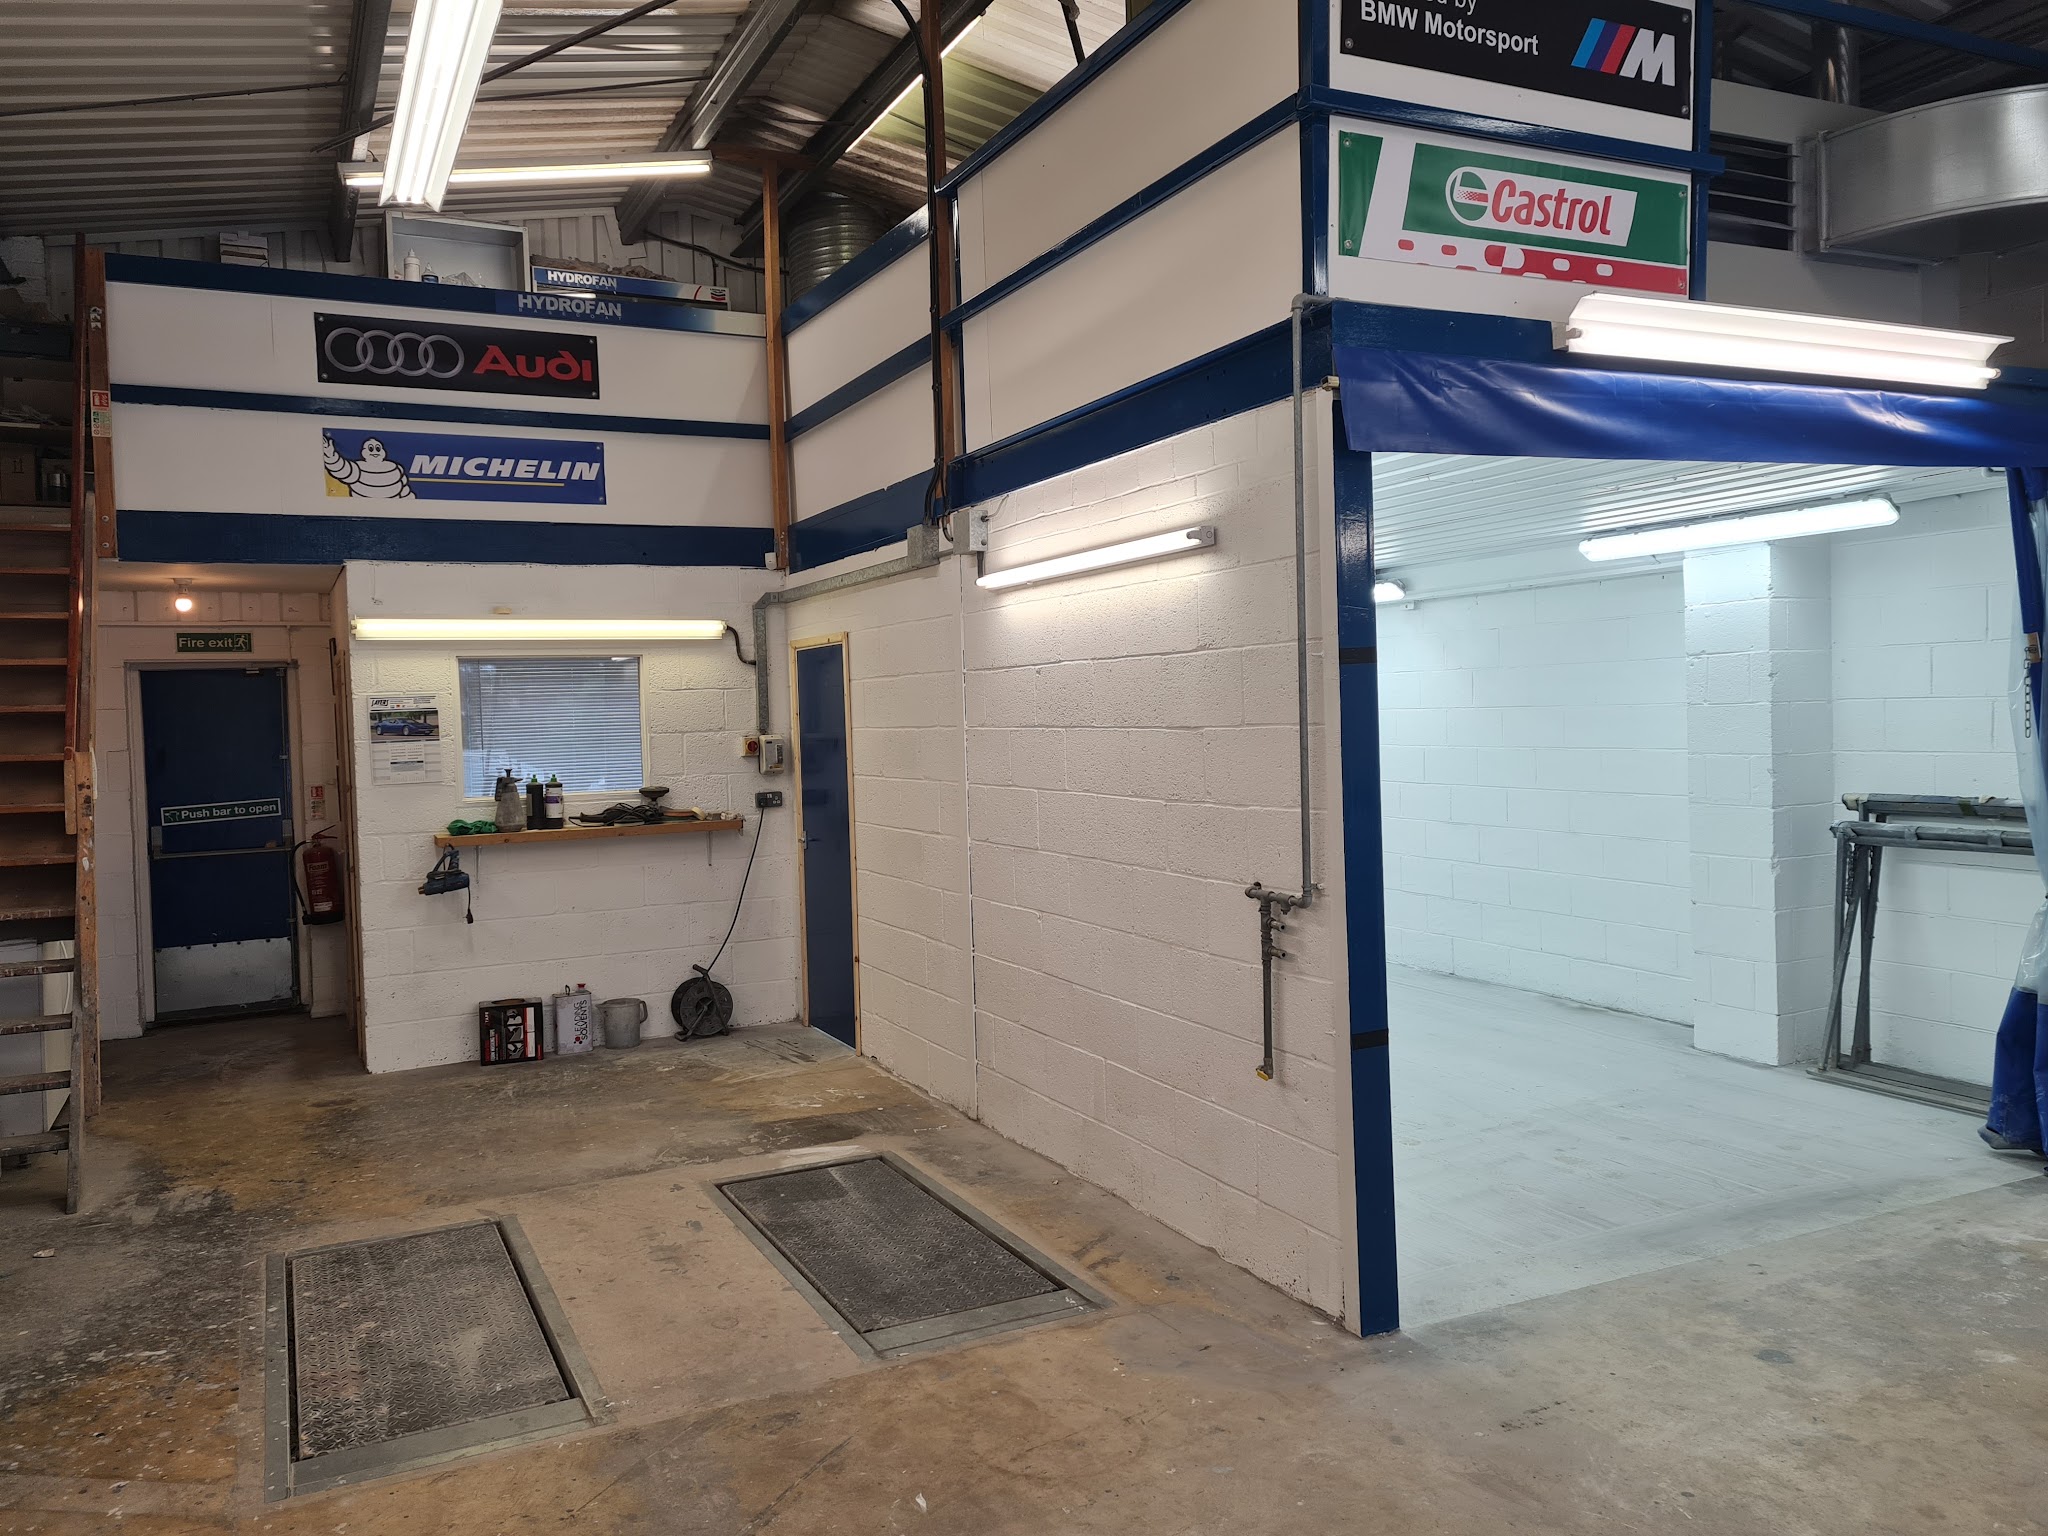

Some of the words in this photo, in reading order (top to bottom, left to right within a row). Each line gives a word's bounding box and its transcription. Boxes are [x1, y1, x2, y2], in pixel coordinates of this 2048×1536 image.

[1361, 0, 1419, 30] BMW
[1424, 11, 1539, 56] Motorsport
[1491, 179, 1613, 236] Castrol
[547, 270, 617, 288] HYDROFAN
[518, 293, 622, 317] HYDROFAN
[473, 345, 593, 382] Audi
[409, 454, 600, 482] MICHELIN
[179, 637, 205, 648] Fire
[208, 637, 233, 648] exit
[181, 808, 210, 819] Push
[212, 807, 231, 817] bar
[234, 806, 245, 814] to
[249, 804, 277, 814] open
[308, 862, 328, 871] Foam
[580, 999, 588, 1040] SOLVENTS
